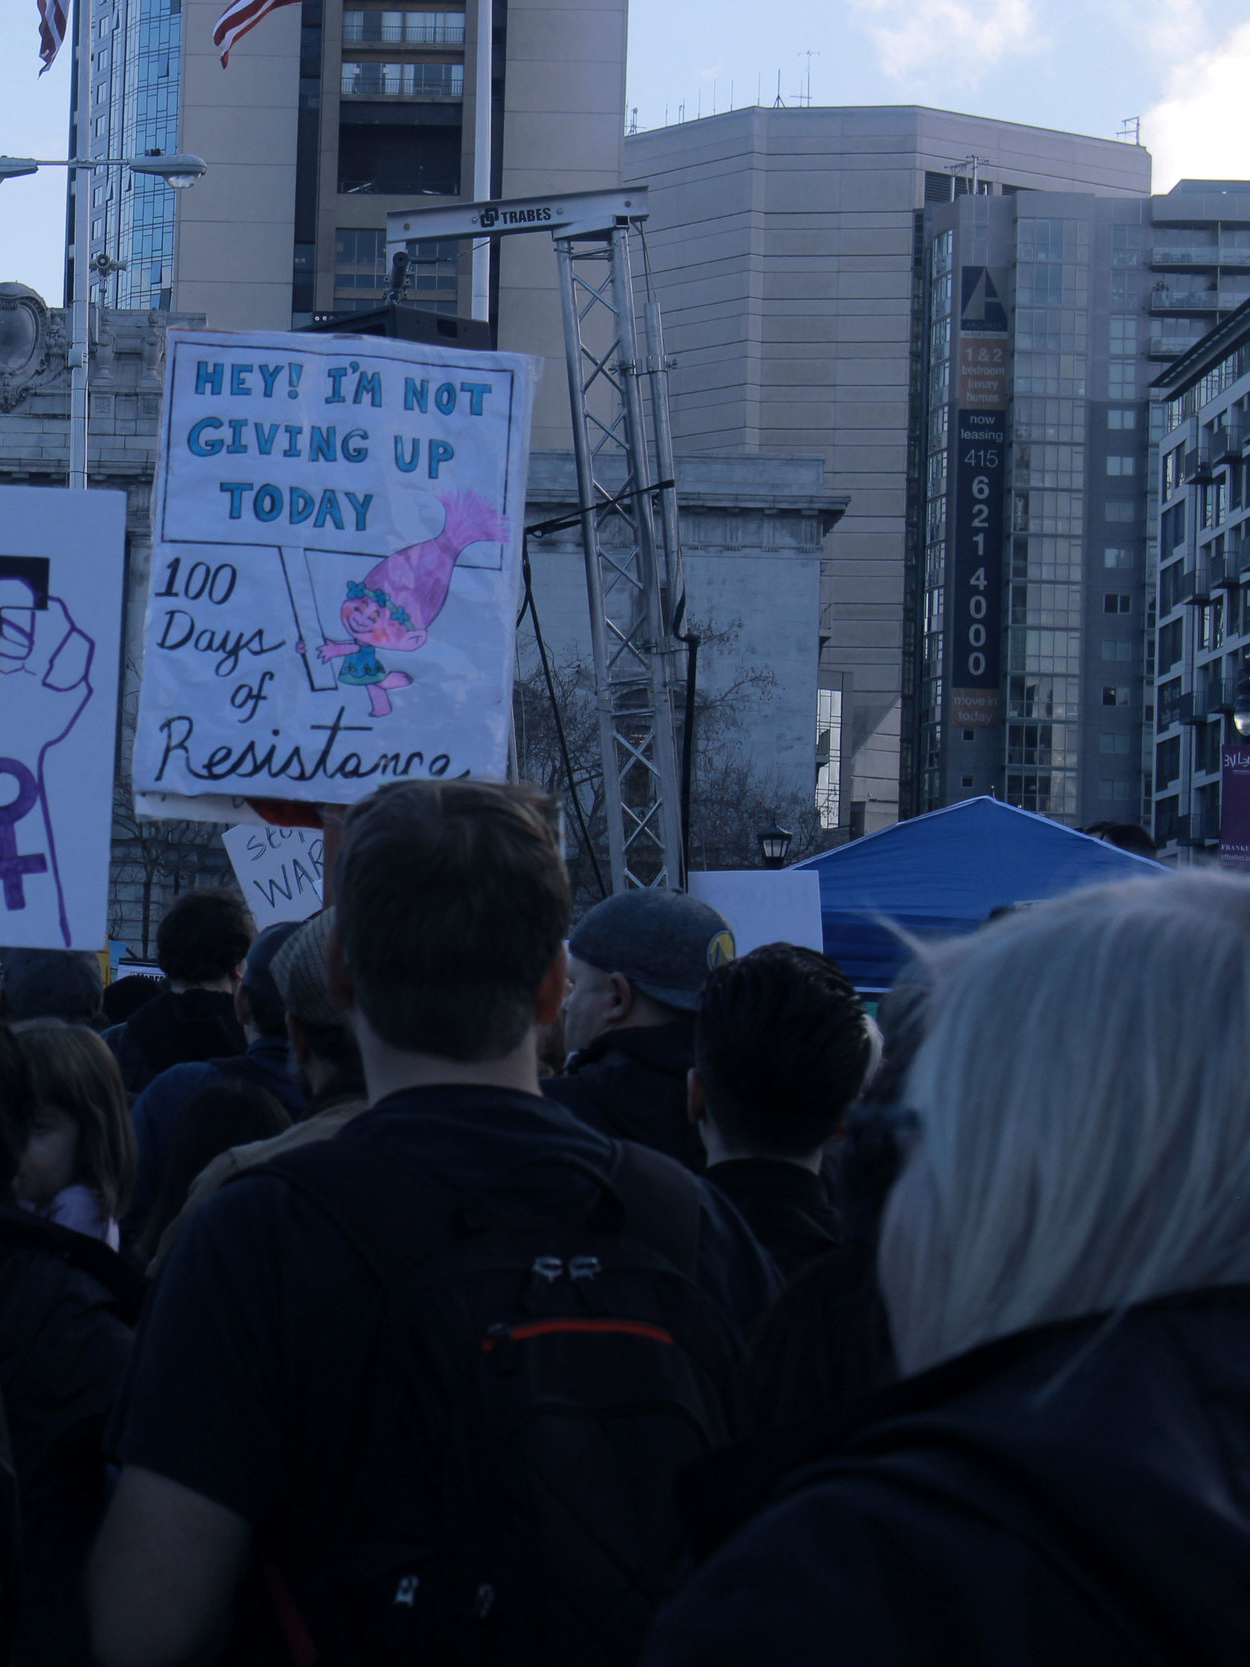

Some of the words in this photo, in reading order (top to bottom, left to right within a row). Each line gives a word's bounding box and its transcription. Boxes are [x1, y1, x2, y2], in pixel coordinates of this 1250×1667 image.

[500, 207, 551, 225] TRABES
[966, 347, 974, 361] 1
[978, 347, 989, 362] &
[993, 347, 1003, 362] 2
[961, 364, 1005, 376] bedroom
[195, 359, 303, 400] HEY!
[324, 360, 383, 408] I'M
[403, 376, 493, 417] NOT
[970, 415, 996, 425] now
[960, 428, 1004, 442] leasing
[187, 416, 369, 464] GIVING
[393, 434, 456, 479] UP
[964, 449, 999, 468] 415
[219, 481, 374, 532] TODAY
[154, 556, 238, 604] 100
[156, 609, 287, 677] Days
[230, 671, 274, 723] of
[953, 696, 984, 707] move
[958, 710, 993, 724] today
